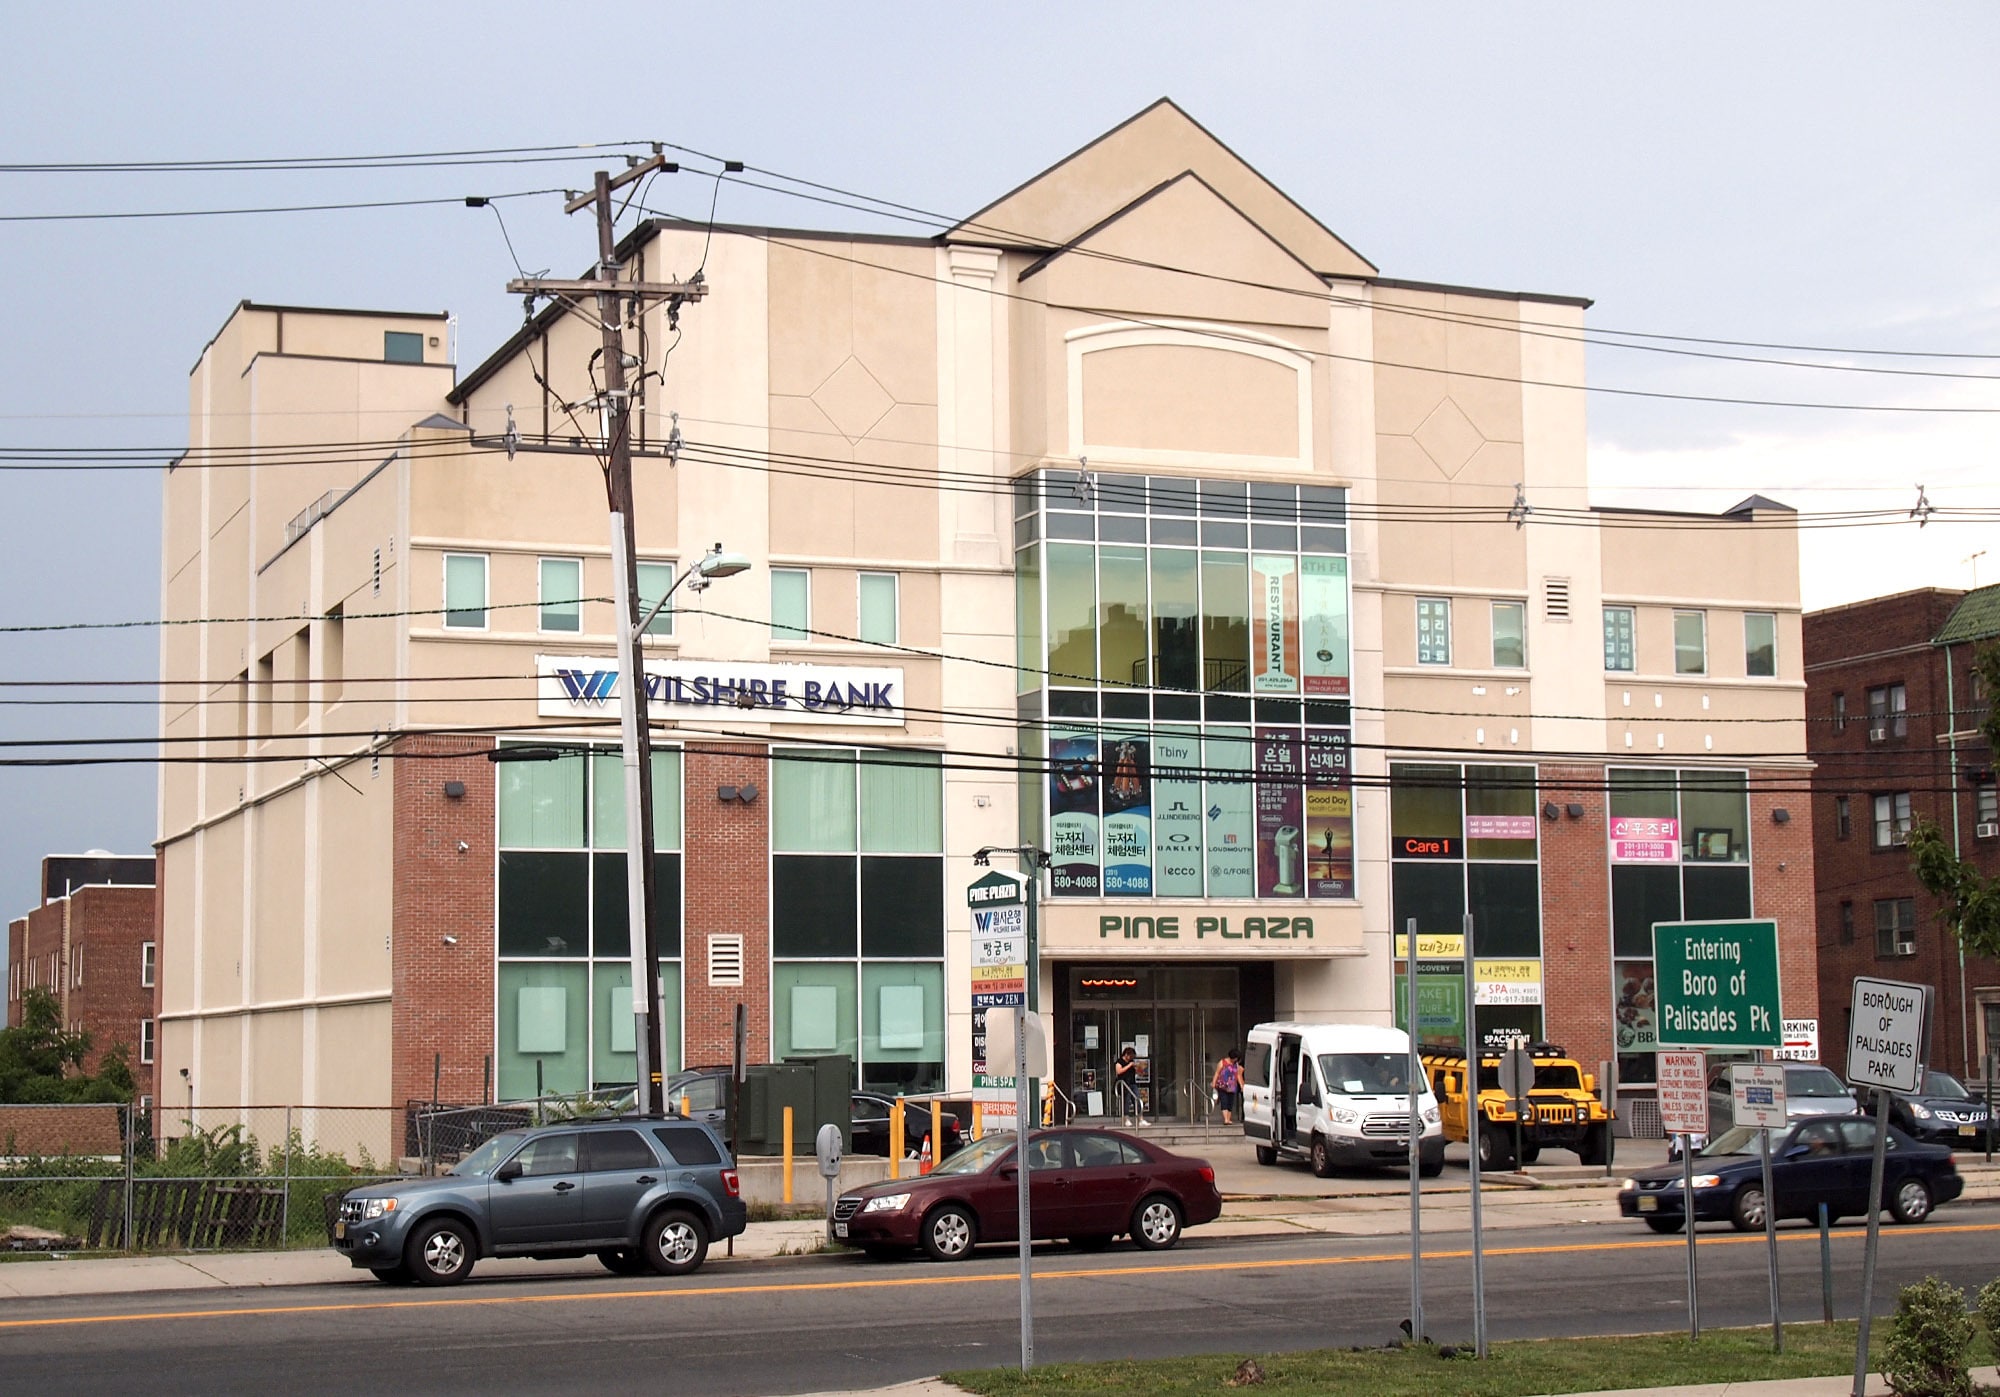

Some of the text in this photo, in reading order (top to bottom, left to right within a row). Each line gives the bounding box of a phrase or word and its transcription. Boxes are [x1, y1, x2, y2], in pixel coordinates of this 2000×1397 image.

[1301, 561, 1326, 573] 4TH
[1330, 563, 1345, 573] FL
[1269, 575, 1281, 673] RESTAURANT
[643, 675, 894, 711] WILSHIRE BANK
[1158, 746, 1188, 759] Tbiny
[1309, 753, 1346, 769] 신체의
[1308, 795, 1348, 805] Good Day
[1616, 822, 1674, 836] 산후조리
[1054, 832, 1084, 843] 뉴저지
[1106, 832, 1136, 844] 뉴저지
[1055, 844, 1094, 856] 체험센터
[1107, 845, 1146, 857] 체험센터
[1405, 839, 1449, 854] Care 1
[1167, 867, 1196, 876] ecco
[1223, 868, 1251, 876] G/FORE
[1054, 876, 1097, 888] 580-4088
[1106, 877, 1149, 888] 580-4088
[970, 884, 1016, 902] PINE PLAZA
[1099, 915, 1314, 939] PINE PLAZA
[1685, 937, 1741, 965] Entering
[1417, 964, 1450, 972] SCOVERY
[1683, 969, 1746, 996] Boro of
[1418, 988, 1442, 999] AKE
[1488, 984, 1508, 994] SPA
[1004, 994, 1019, 1005] ZEN
[1863, 992, 1914, 1013] BOROUGH
[1665, 1004, 1771, 1032] Palisades Pk
[1783, 1022, 1816, 1032] ARKING
[1879, 1017, 1893, 1032] OF
[974, 1036, 986, 1047] DIS
[1484, 1034, 1510, 1044] SPACE
[1855, 1035, 1913, 1059] PALISADES
[1665, 1056, 1697, 1067] WARNING
[1662, 1068, 1700, 1079] USE OF MOBILE
[1868, 1060, 1897, 1079] PARK
[981, 1077, 1014, 1088] PINE SPA
[1660, 1080, 1704, 1089] TELEPHONES PROHIBITED
[1663, 1091, 1702, 1101] WHILE DRIVING
[1662, 1102, 1703, 1112] UNLESS USING A
[1690, 1114, 1704, 1123] DEVICE
